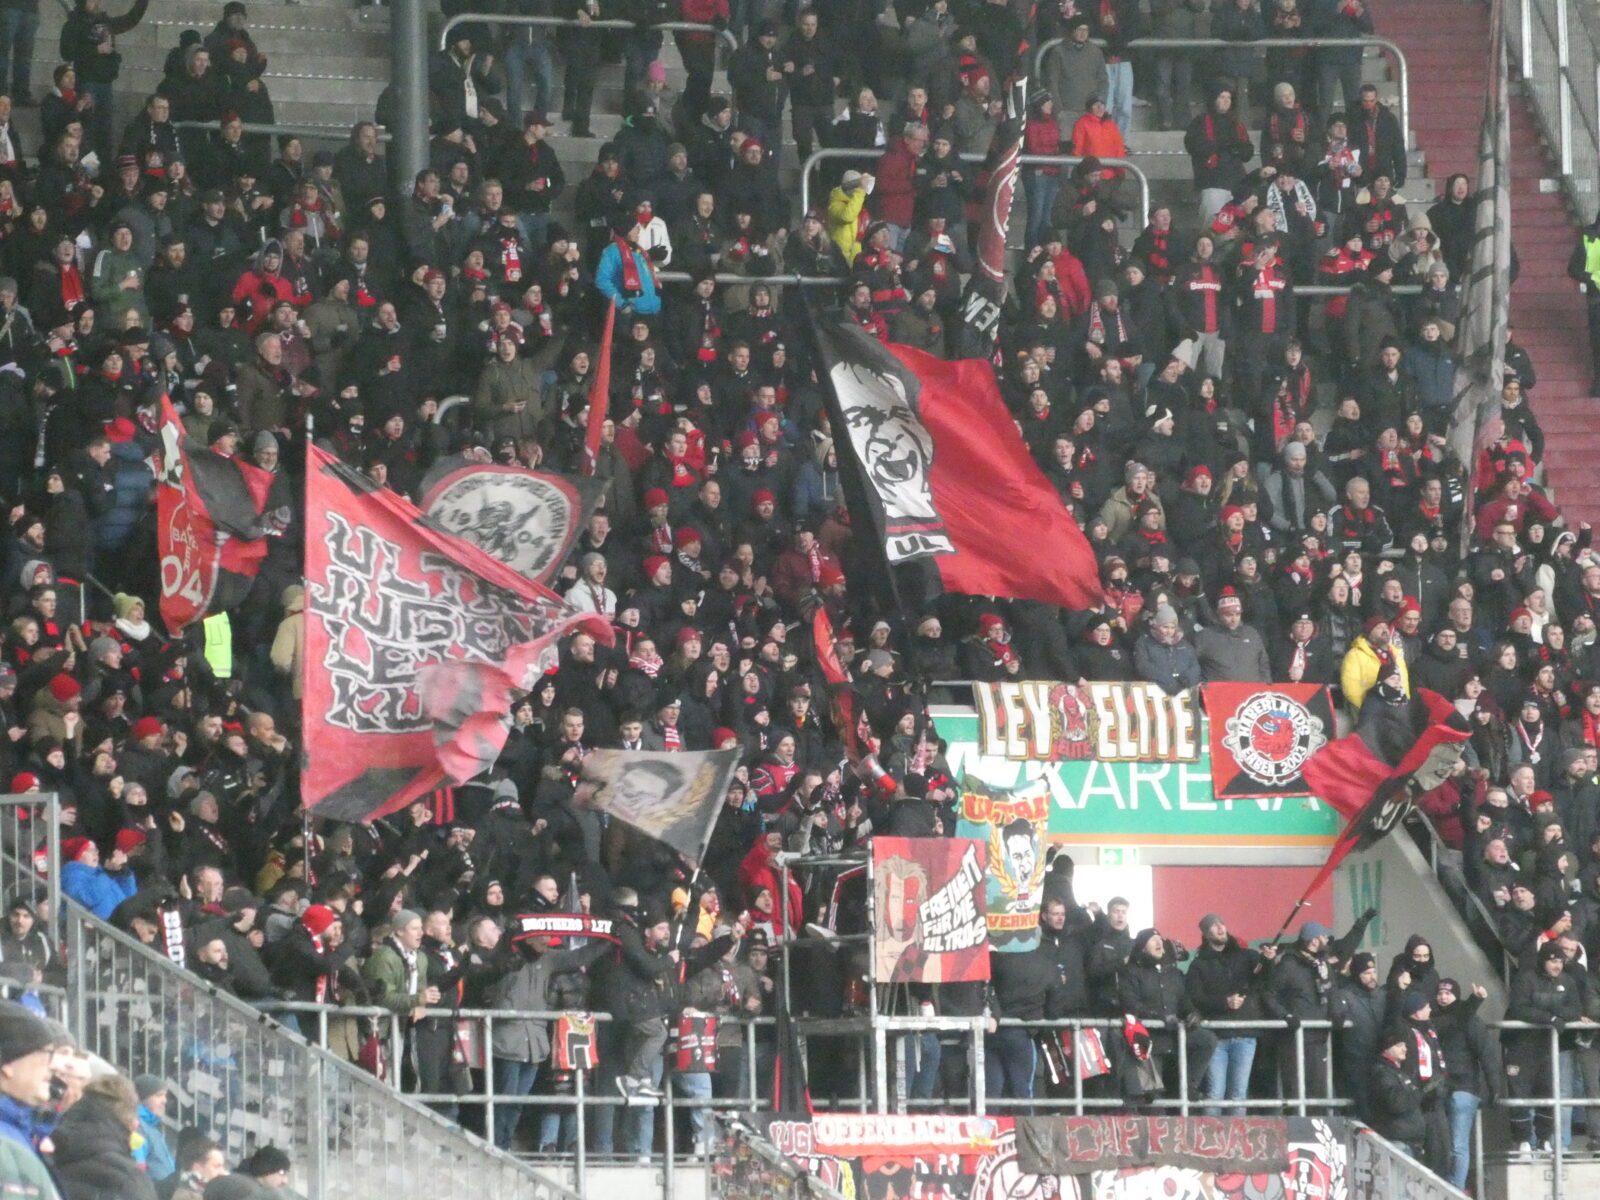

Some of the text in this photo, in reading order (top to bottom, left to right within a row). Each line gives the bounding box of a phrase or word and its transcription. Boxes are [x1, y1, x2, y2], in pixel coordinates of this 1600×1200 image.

[161, 554, 204, 607] 04
[977, 681, 1196, 762] LEV ELITE
[1279, 746, 1309, 773] 2003
[953, 891, 976, 929] DIE
[923, 916, 987, 952] ULTRAS
